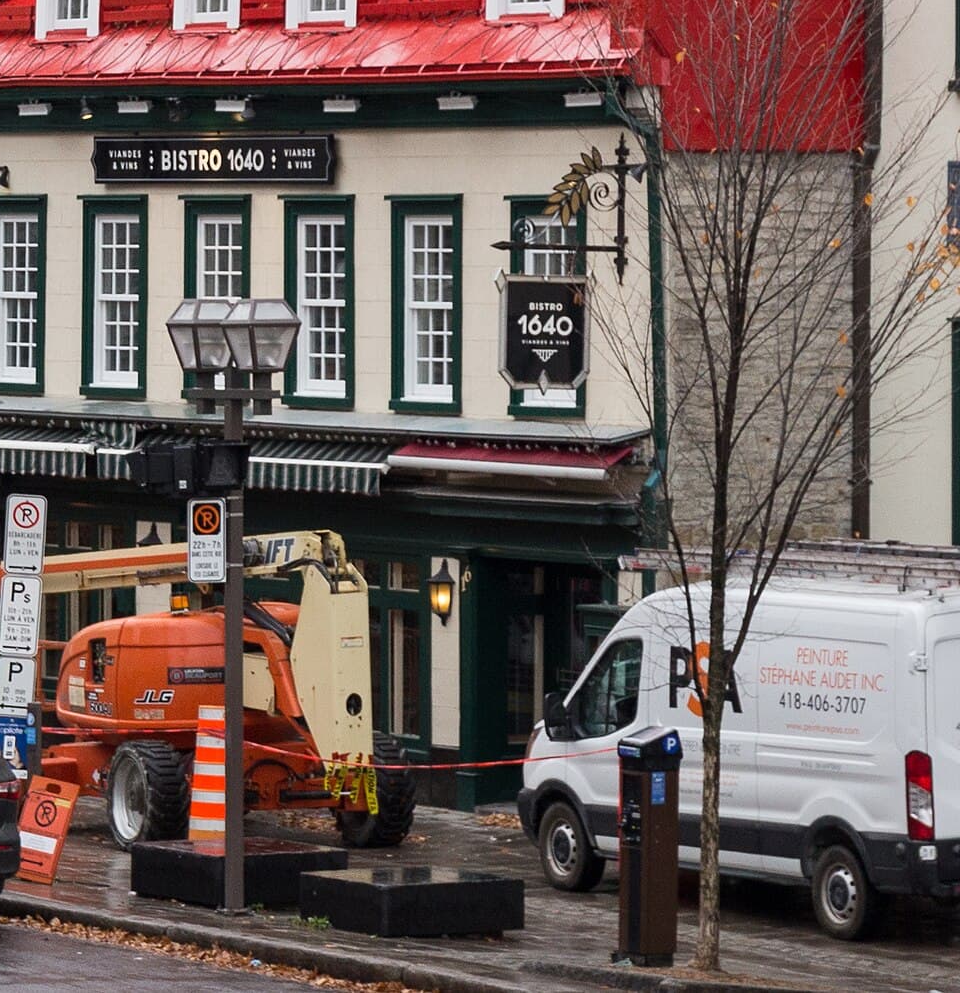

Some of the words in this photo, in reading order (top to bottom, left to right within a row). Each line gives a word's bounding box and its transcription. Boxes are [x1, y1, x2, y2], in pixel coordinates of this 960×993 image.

[109, 150, 141, 158] VIANDES
[161, 149, 222, 172] BISTRO
[227, 148, 265, 172] 1640
[284, 149, 316, 157] VIANDES
[120, 162, 138, 170] VINS
[295, 161, 313, 169] VINS
[529, 302, 563, 311] BISTRO
[518, 314, 573, 336] 1640
[265, 538, 295, 564] IFT
[796, 647, 848, 667] PEINTURE
[8, 662, 23, 682] P
[759, 662, 817, 687] STÉPHANE
[820, 673, 857, 691] AUDET
[861, 675, 887, 693] INC.
[135, 690, 176, 704] JLG
[779, 692, 866, 714] 418-406-3707
[667, 738, 677, 751] P
